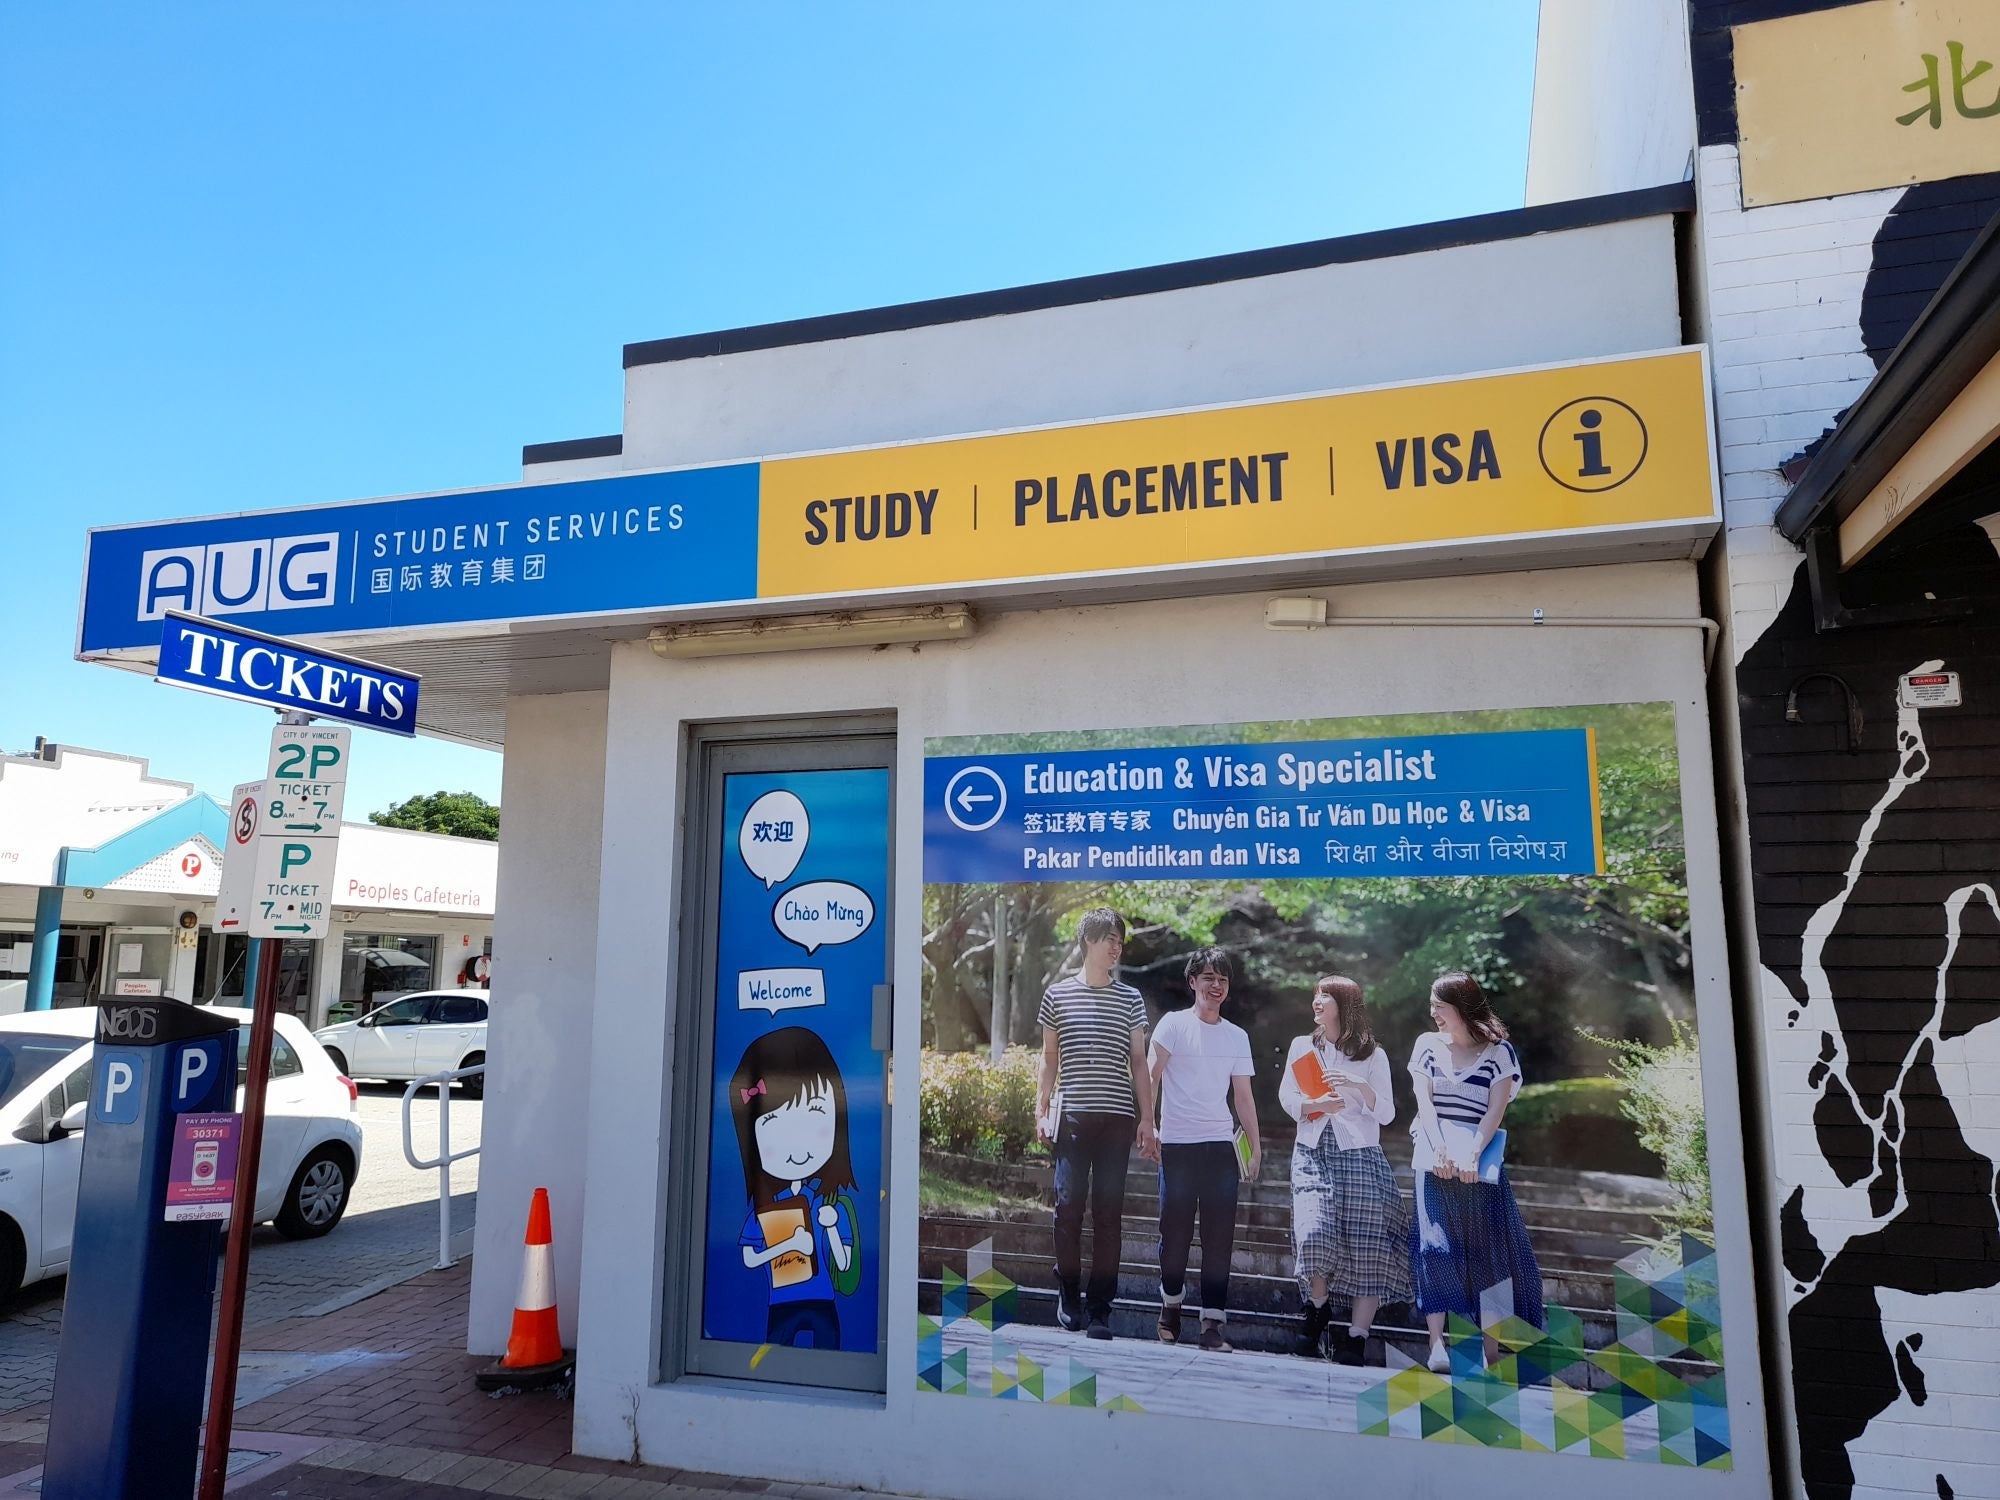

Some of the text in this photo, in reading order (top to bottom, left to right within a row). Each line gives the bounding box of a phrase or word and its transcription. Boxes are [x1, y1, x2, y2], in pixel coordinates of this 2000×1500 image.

[1895, 40, 2000, 129] 北
[804, 429, 1502, 545] STUDY PLACEMENT VISA
[373, 504, 684, 557] STUDENT SERVICES
[146, 541, 331, 614] AUG
[371, 554, 546, 594] 国际教育集团
[180, 629, 404, 720] TICKETS
[312, 732, 339, 740] VINCENT
[275, 743, 341, 779] 2P
[1024, 749, 1436, 794] Education & Visa Specialist
[279, 784, 331, 796] TICKET
[752, 820, 794, 843] 欢迎
[1024, 810, 1151, 834] 签证教育专家
[1172, 798, 1530, 834] Chuyên Gia Tư Vấn Du Học & Visa
[280, 844, 312, 878] P
[1024, 842, 1300, 869] Pakar Pendidikan dan Visa
[1324, 839, 1377, 864] शिक्षा
[1385, 836, 1423, 863] और
[1431, 836, 1481, 861] वीजा
[267, 884, 319, 896] TICKET
[348, 879, 481, 907] Peoples Cafeteria
[300, 902, 323, 914] MID
[784, 900, 864, 927] Chào Mừng
[749, 979, 812, 1000] Welcome
[105, 1062, 133, 1113] P
[179, 1048, 208, 1099] P
[193, 1129, 223, 1139] 30371
